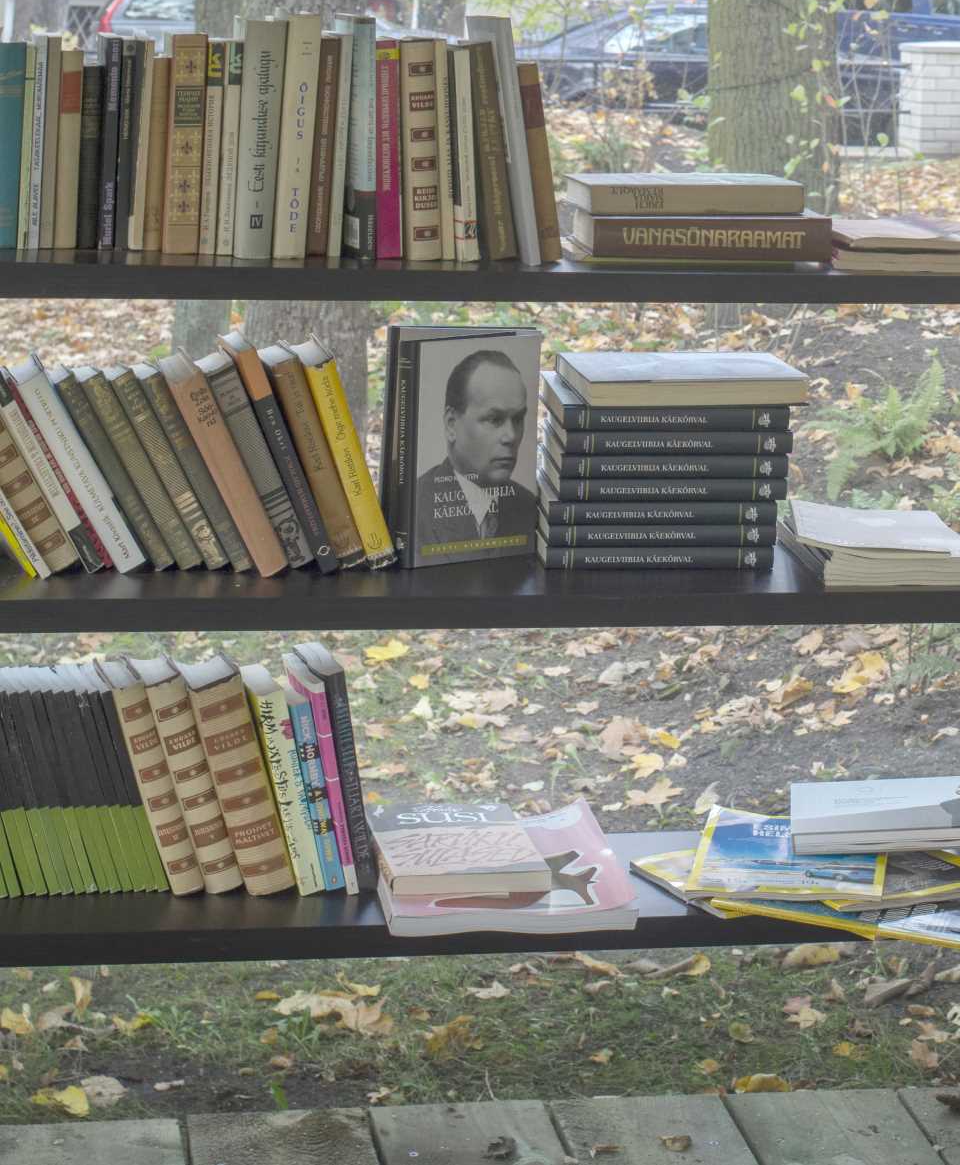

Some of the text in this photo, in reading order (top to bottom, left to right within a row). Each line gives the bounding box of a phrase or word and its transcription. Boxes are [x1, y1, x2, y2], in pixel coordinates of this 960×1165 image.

[249, 51, 276, 193] Eesti kirjanduse ajalugu
[101, 181, 115, 210] Spark
[622, 226, 806, 249] VANASÕNARAAMAT
[601, 414, 708, 424] KAUGELVIIBIJA KÄEKÕRVAL
[667, 439, 713, 448] KÄEKÕRVAL
[601, 463, 709, 472] KAUGELVIIBIJA KÄEKÕRVAL
[600, 486, 708, 495] KAUGELVIIBIJA KÄEKÕRVAL
[586, 510, 694, 519] KAUGELVIIBIJA KÄEKÕRVAL
[588, 531, 696, 540] KAUGELVIIBIJA KÄEKÕRVAL
[585, 555, 693, 563] KAUGELVIIBIJA KÄEKÕRVAL
